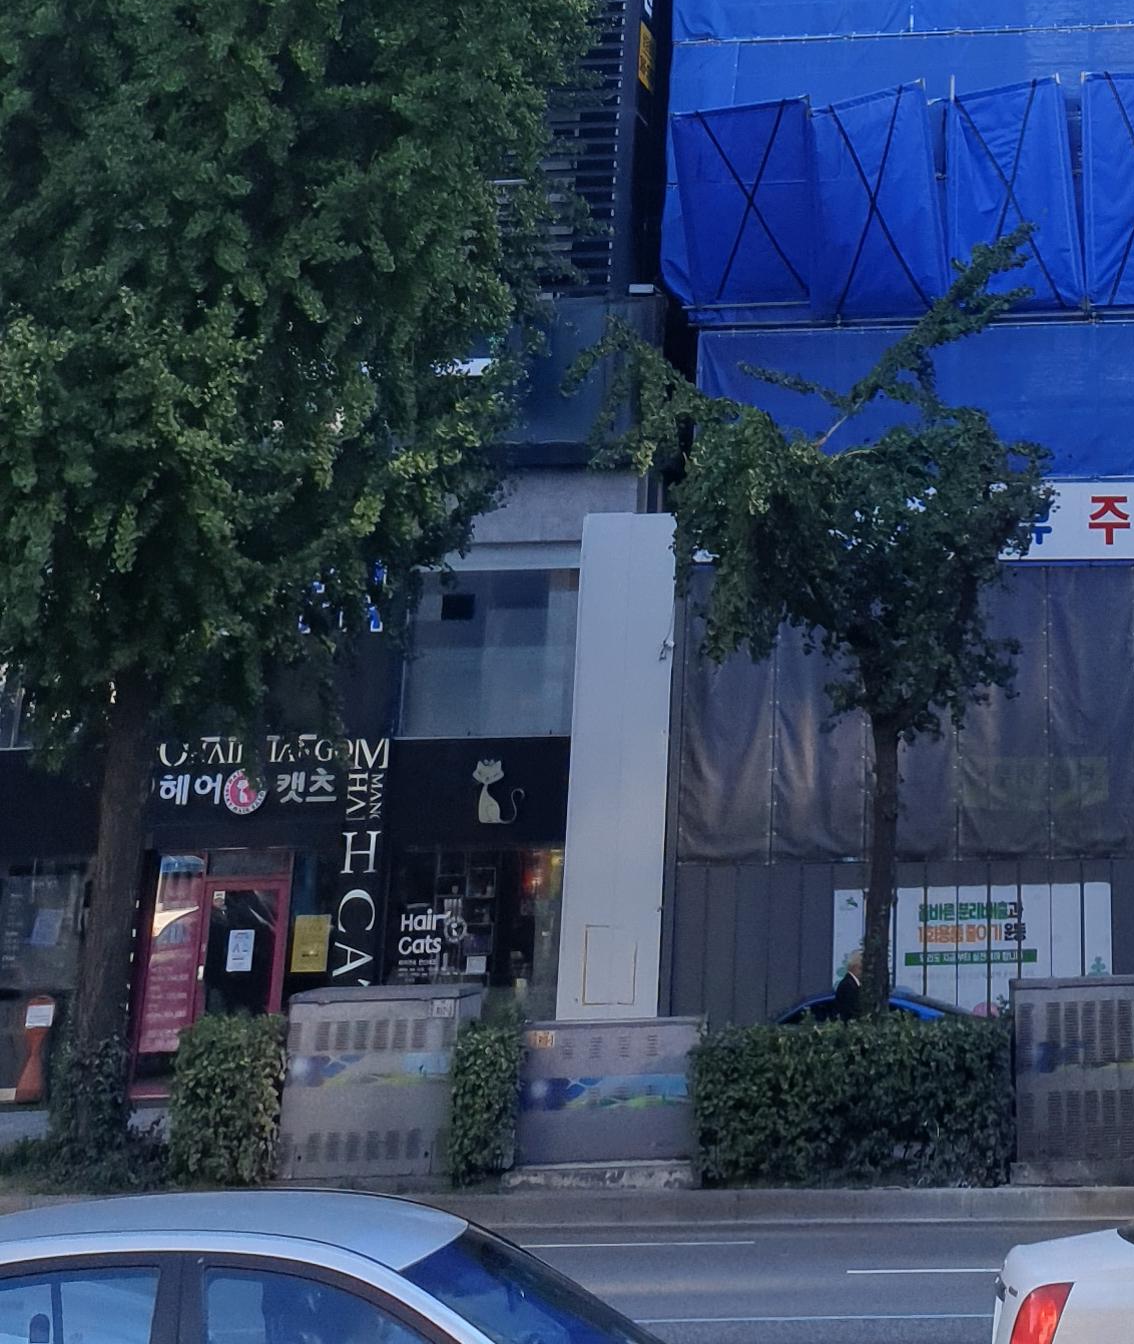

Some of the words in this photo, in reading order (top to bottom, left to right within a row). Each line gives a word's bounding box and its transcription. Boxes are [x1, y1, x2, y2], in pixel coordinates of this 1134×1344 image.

[159, 772, 223, 806] 헤어
[276, 767, 338, 804] 캣츠
[400, 907, 451, 932] Hair
[398, 934, 442, 955] Cats
